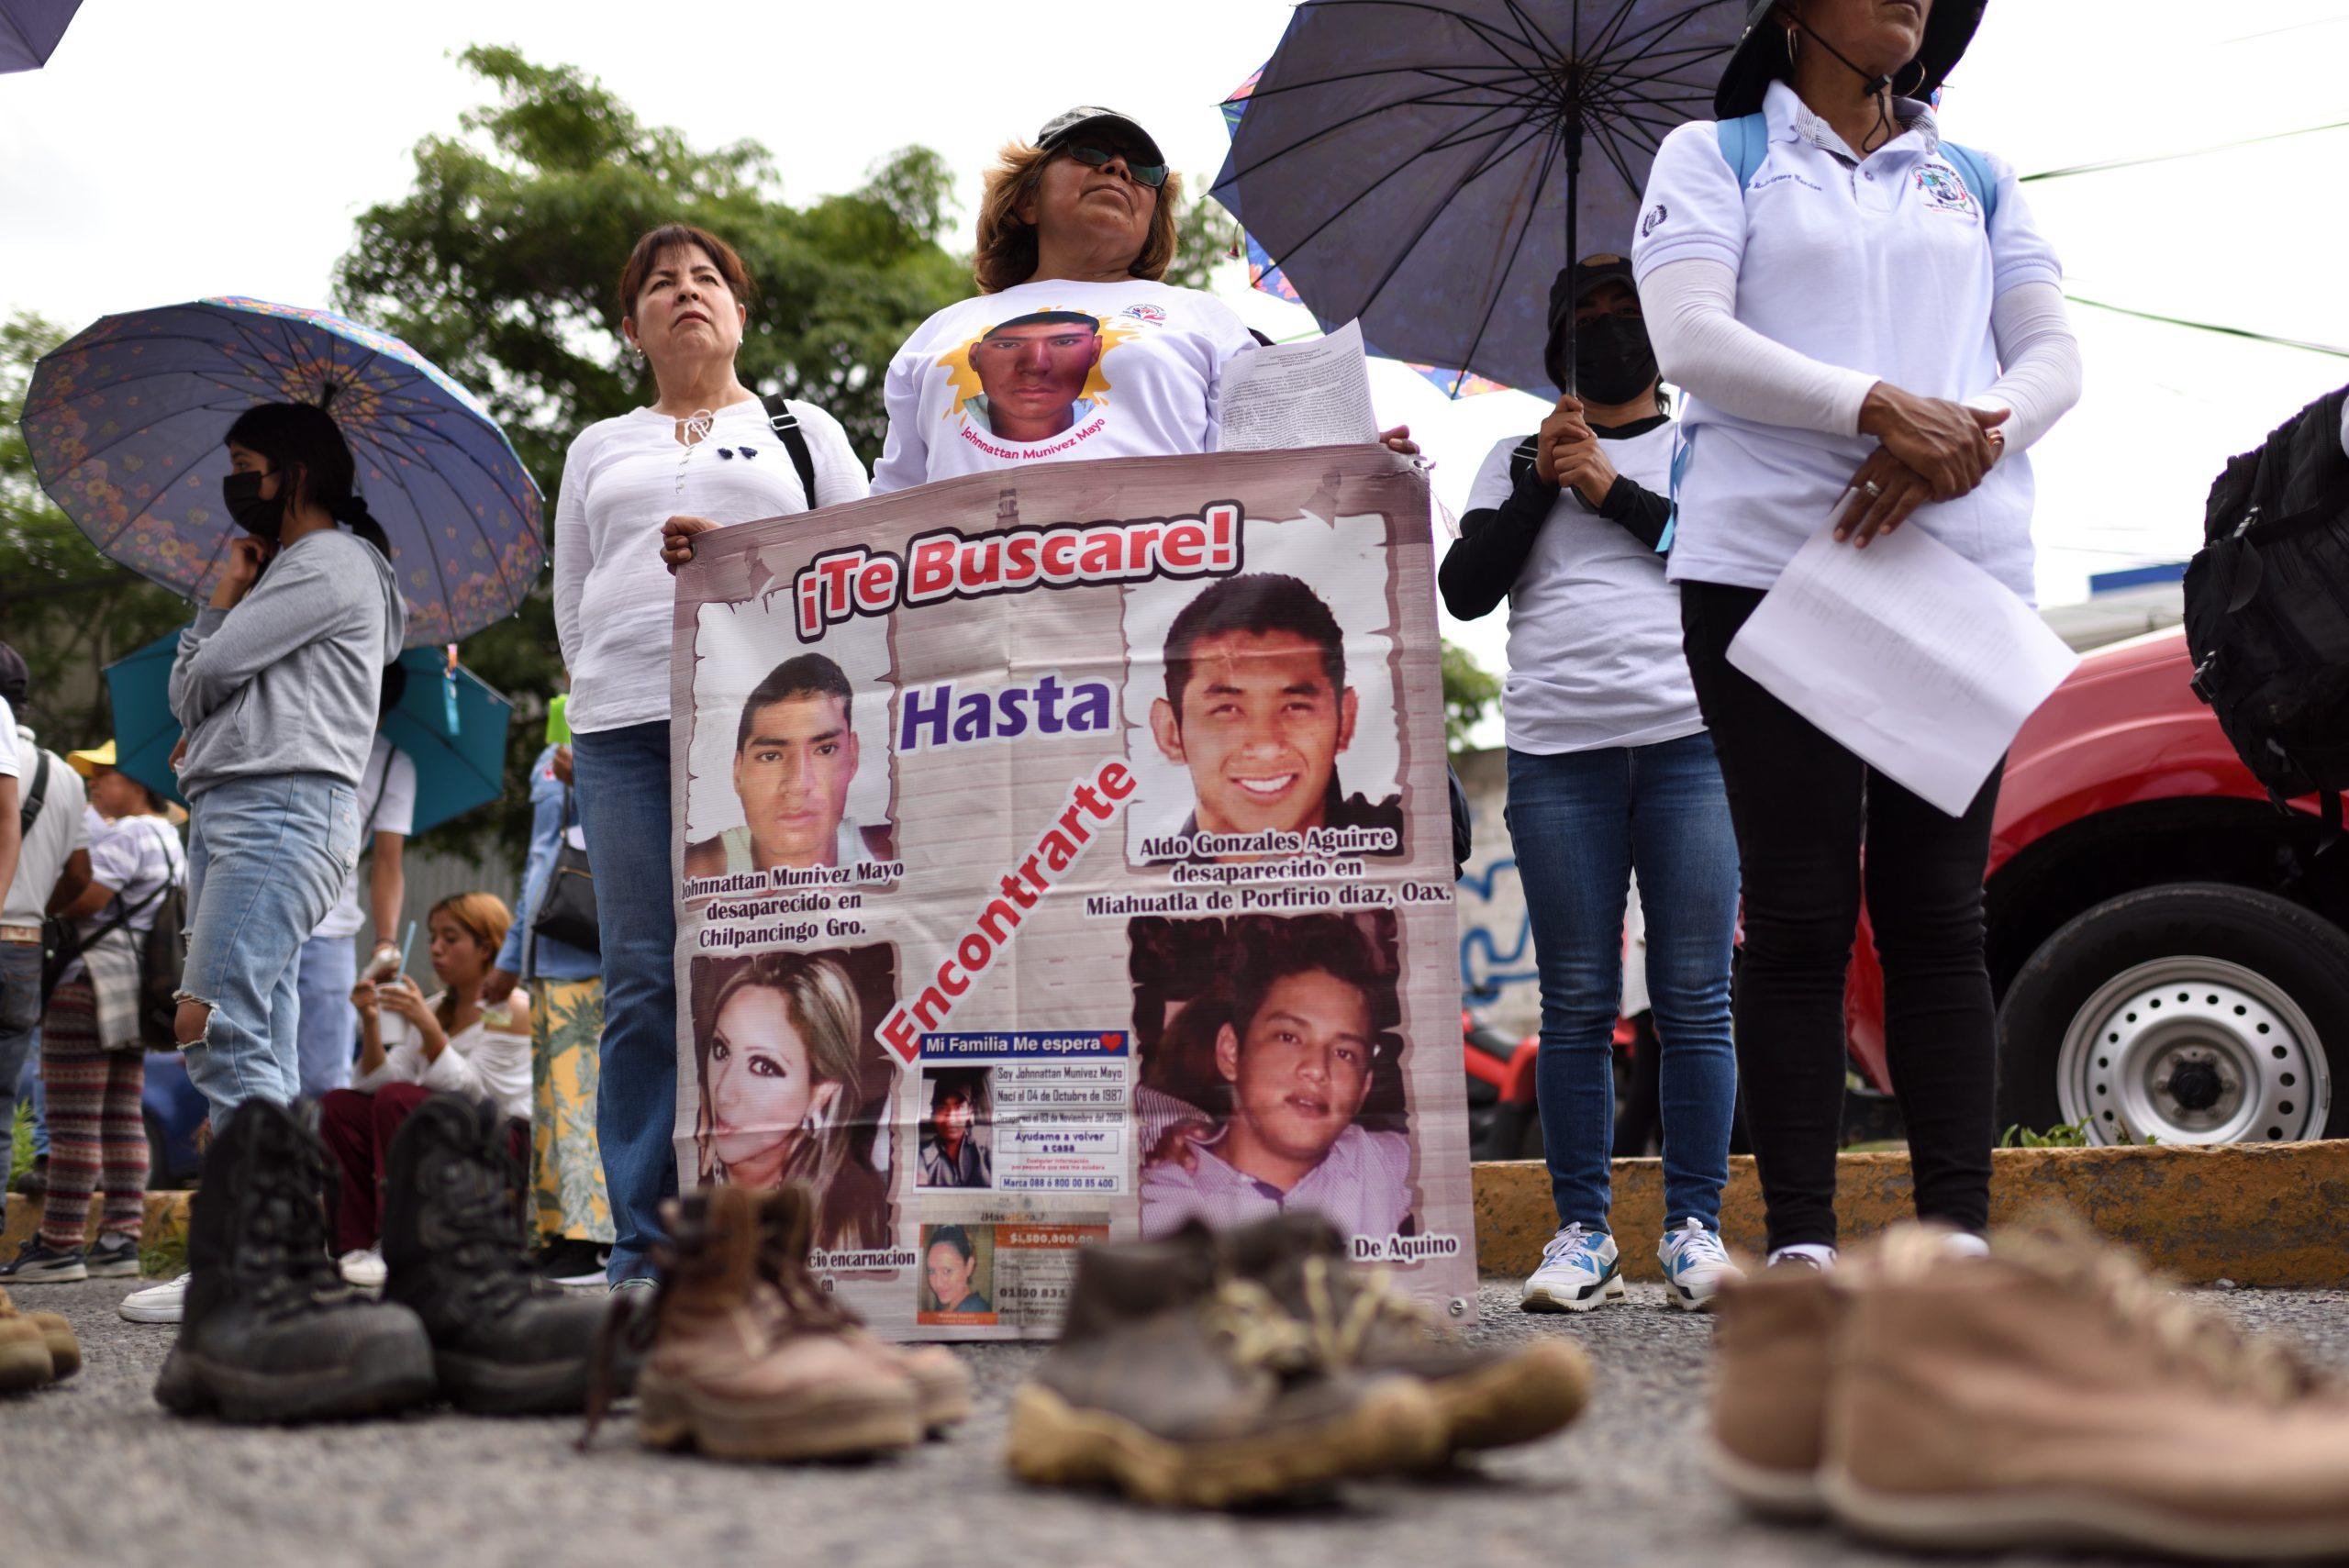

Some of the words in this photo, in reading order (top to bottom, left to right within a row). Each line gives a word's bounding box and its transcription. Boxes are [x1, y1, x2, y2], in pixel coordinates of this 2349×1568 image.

[961, 427, 1019, 459] Johnnattan
[1022, 439, 1077, 460] Munivez
[1074, 417, 1106, 441] Mayo
[802, 555, 895, 630] ¡Te
[911, 510, 1231, 596] Buscare!
[899, 674, 1111, 751] Hasta
[1140, 837, 1188, 857] Aldo
[1196, 830, 1300, 854] Gonzales
[1306, 827, 1394, 851] Aguirre
[773, 866, 852, 886] Munivez
[856, 862, 905, 882] Mayo
[1172, 860, 1327, 885] desaparecido
[1334, 861, 1363, 877] en
[707, 893, 830, 920] desaparecido
[837, 894, 862, 908] en
[1086, 893, 1198, 916] Miahuatla
[1207, 890, 1232, 910] de
[1241, 886, 1330, 909] Porfirio
[1339, 883, 1394, 906] díaz,
[1402, 882, 1452, 902] Oax.
[881, 762, 1137, 1065] Encontrarte
[699, 920, 818, 949] Chilpancingo
[826, 918, 866, 936] Gro.
[926, 1038, 945, 1052] Mi
[949, 1036, 1008, 1052] Familia
[1013, 1037, 1039, 1051] Me
[1042, 1037, 1101, 1053] espera
[997, 1067, 1013, 1083] Soy
[1016, 1066, 1062, 1079] Johnnattan
[1064, 1065, 1097, 1078] Munivez
[1100, 1065, 1122, 1082] Mayo
[1018, 1089, 1025, 1101] el
[1028, 1089, 1038, 1101] 04
[1041, 1089, 1051, 1101] de
[1052, 1089, 1087, 1101] Octubre
[1089, 1089, 1100, 1101] de
[1102, 1089, 1123, 1101] 1987
[1051, 1113, 1058, 1123] de
[1060, 1112, 1093, 1123] Noviembre
[1042, 1144, 1049, 1152] a
[1052, 1144, 1074, 1152] casa
[1073, 1131, 1105, 1141] volver
[1003, 1178, 1028, 1188] Marca
[1030, 1178, 1044, 1188] 088
[1054, 1178, 1070, 1188] 800
[1072, 1178, 1083, 1188] 00
[1085, 1178, 1096, 1188] 85
[1097, 1178, 1113, 1188] 400
[830, 1249, 916, 1267] encarnacion
[1354, 1238, 1382, 1258] De
[1388, 1235, 1457, 1259] Aquino
[820, 1279, 834, 1292] en
